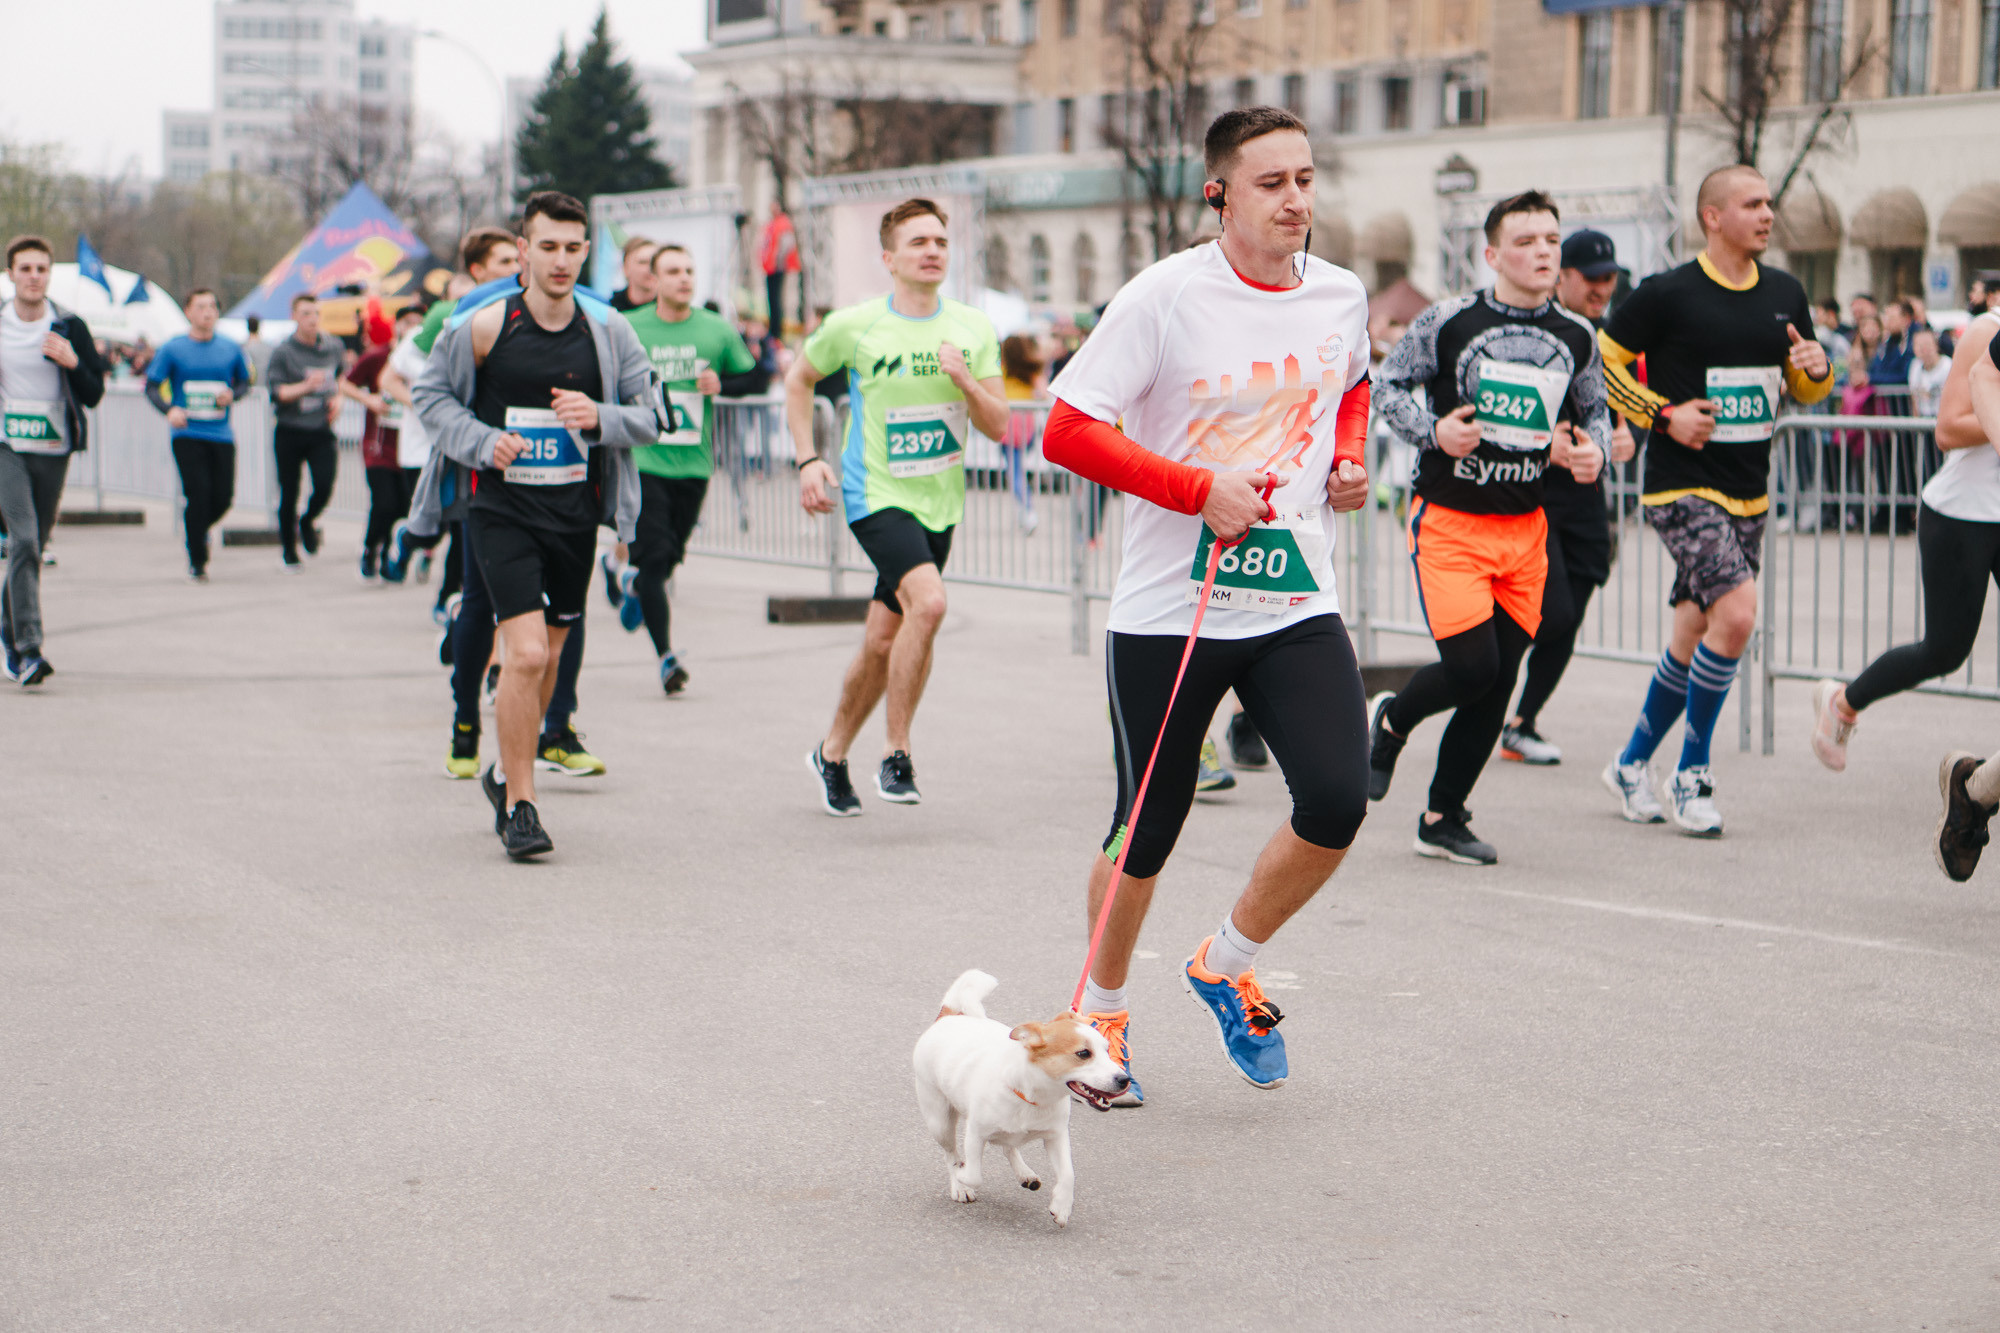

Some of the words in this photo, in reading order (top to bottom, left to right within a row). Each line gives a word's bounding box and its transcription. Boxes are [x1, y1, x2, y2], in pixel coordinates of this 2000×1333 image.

[912, 349, 971, 363] MAR
[1478, 390, 1537, 421] 3247
[890, 430, 946, 455] 2397
[1205, 542, 1288, 578] 1680
[1211, 589, 1231, 601] KM
